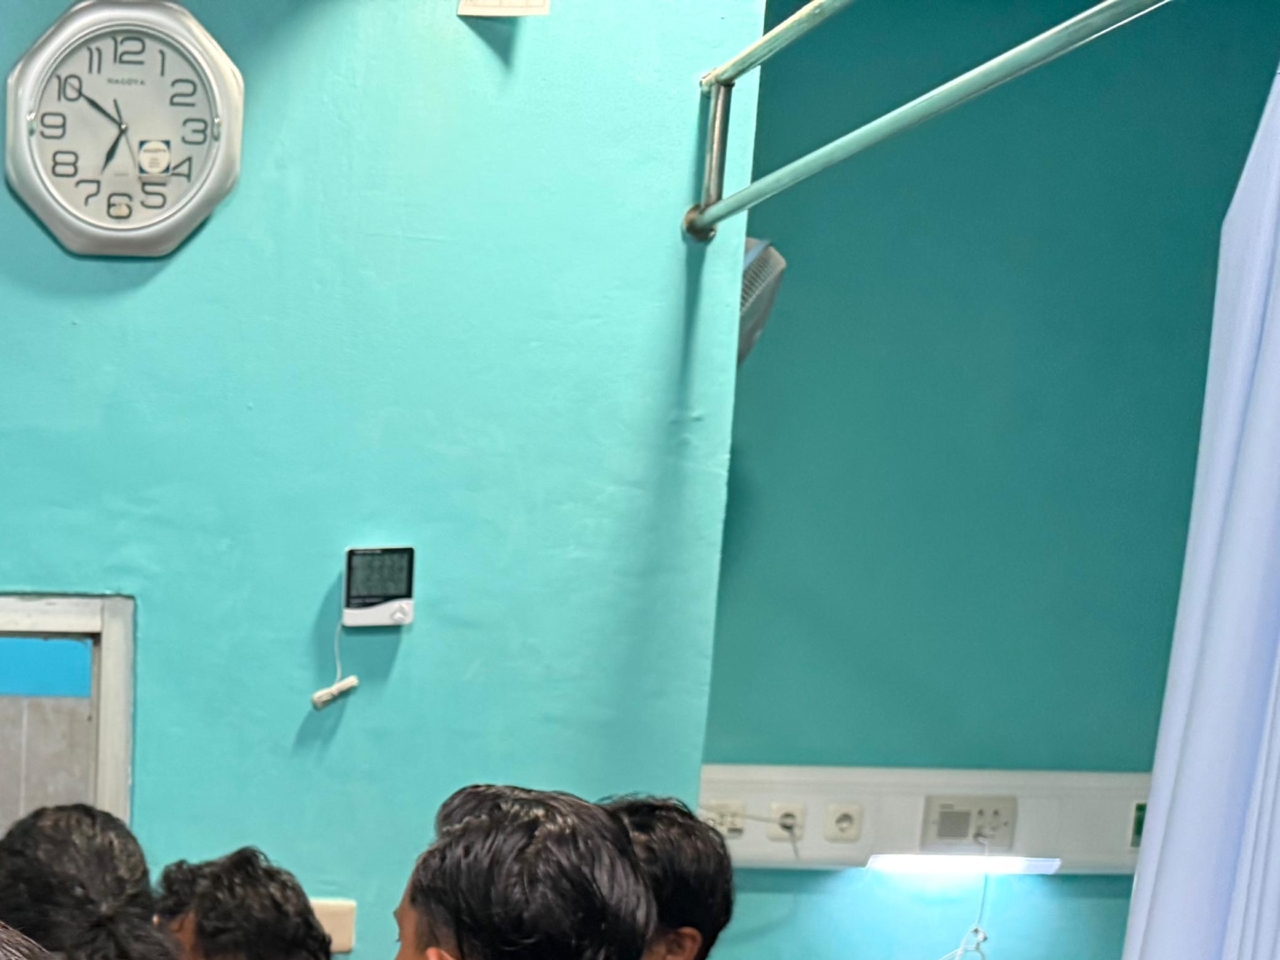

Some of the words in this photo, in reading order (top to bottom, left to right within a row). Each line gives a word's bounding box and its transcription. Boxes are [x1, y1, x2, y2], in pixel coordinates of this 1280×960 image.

[86, 46, 102, 75] 11
[111, 36, 146, 65] 12
[158, 49, 167, 77] 1
[55, 74, 83, 102] 10
[169, 78, 197, 107] 2
[40, 112, 66, 140] 9
[182, 118, 208, 145] 3
[52, 150, 78, 178] 8
[170, 156, 193, 183] 4
[75, 179, 101, 207] 7
[106, 192, 133, 220] 6
[140, 182, 167, 209] 5
